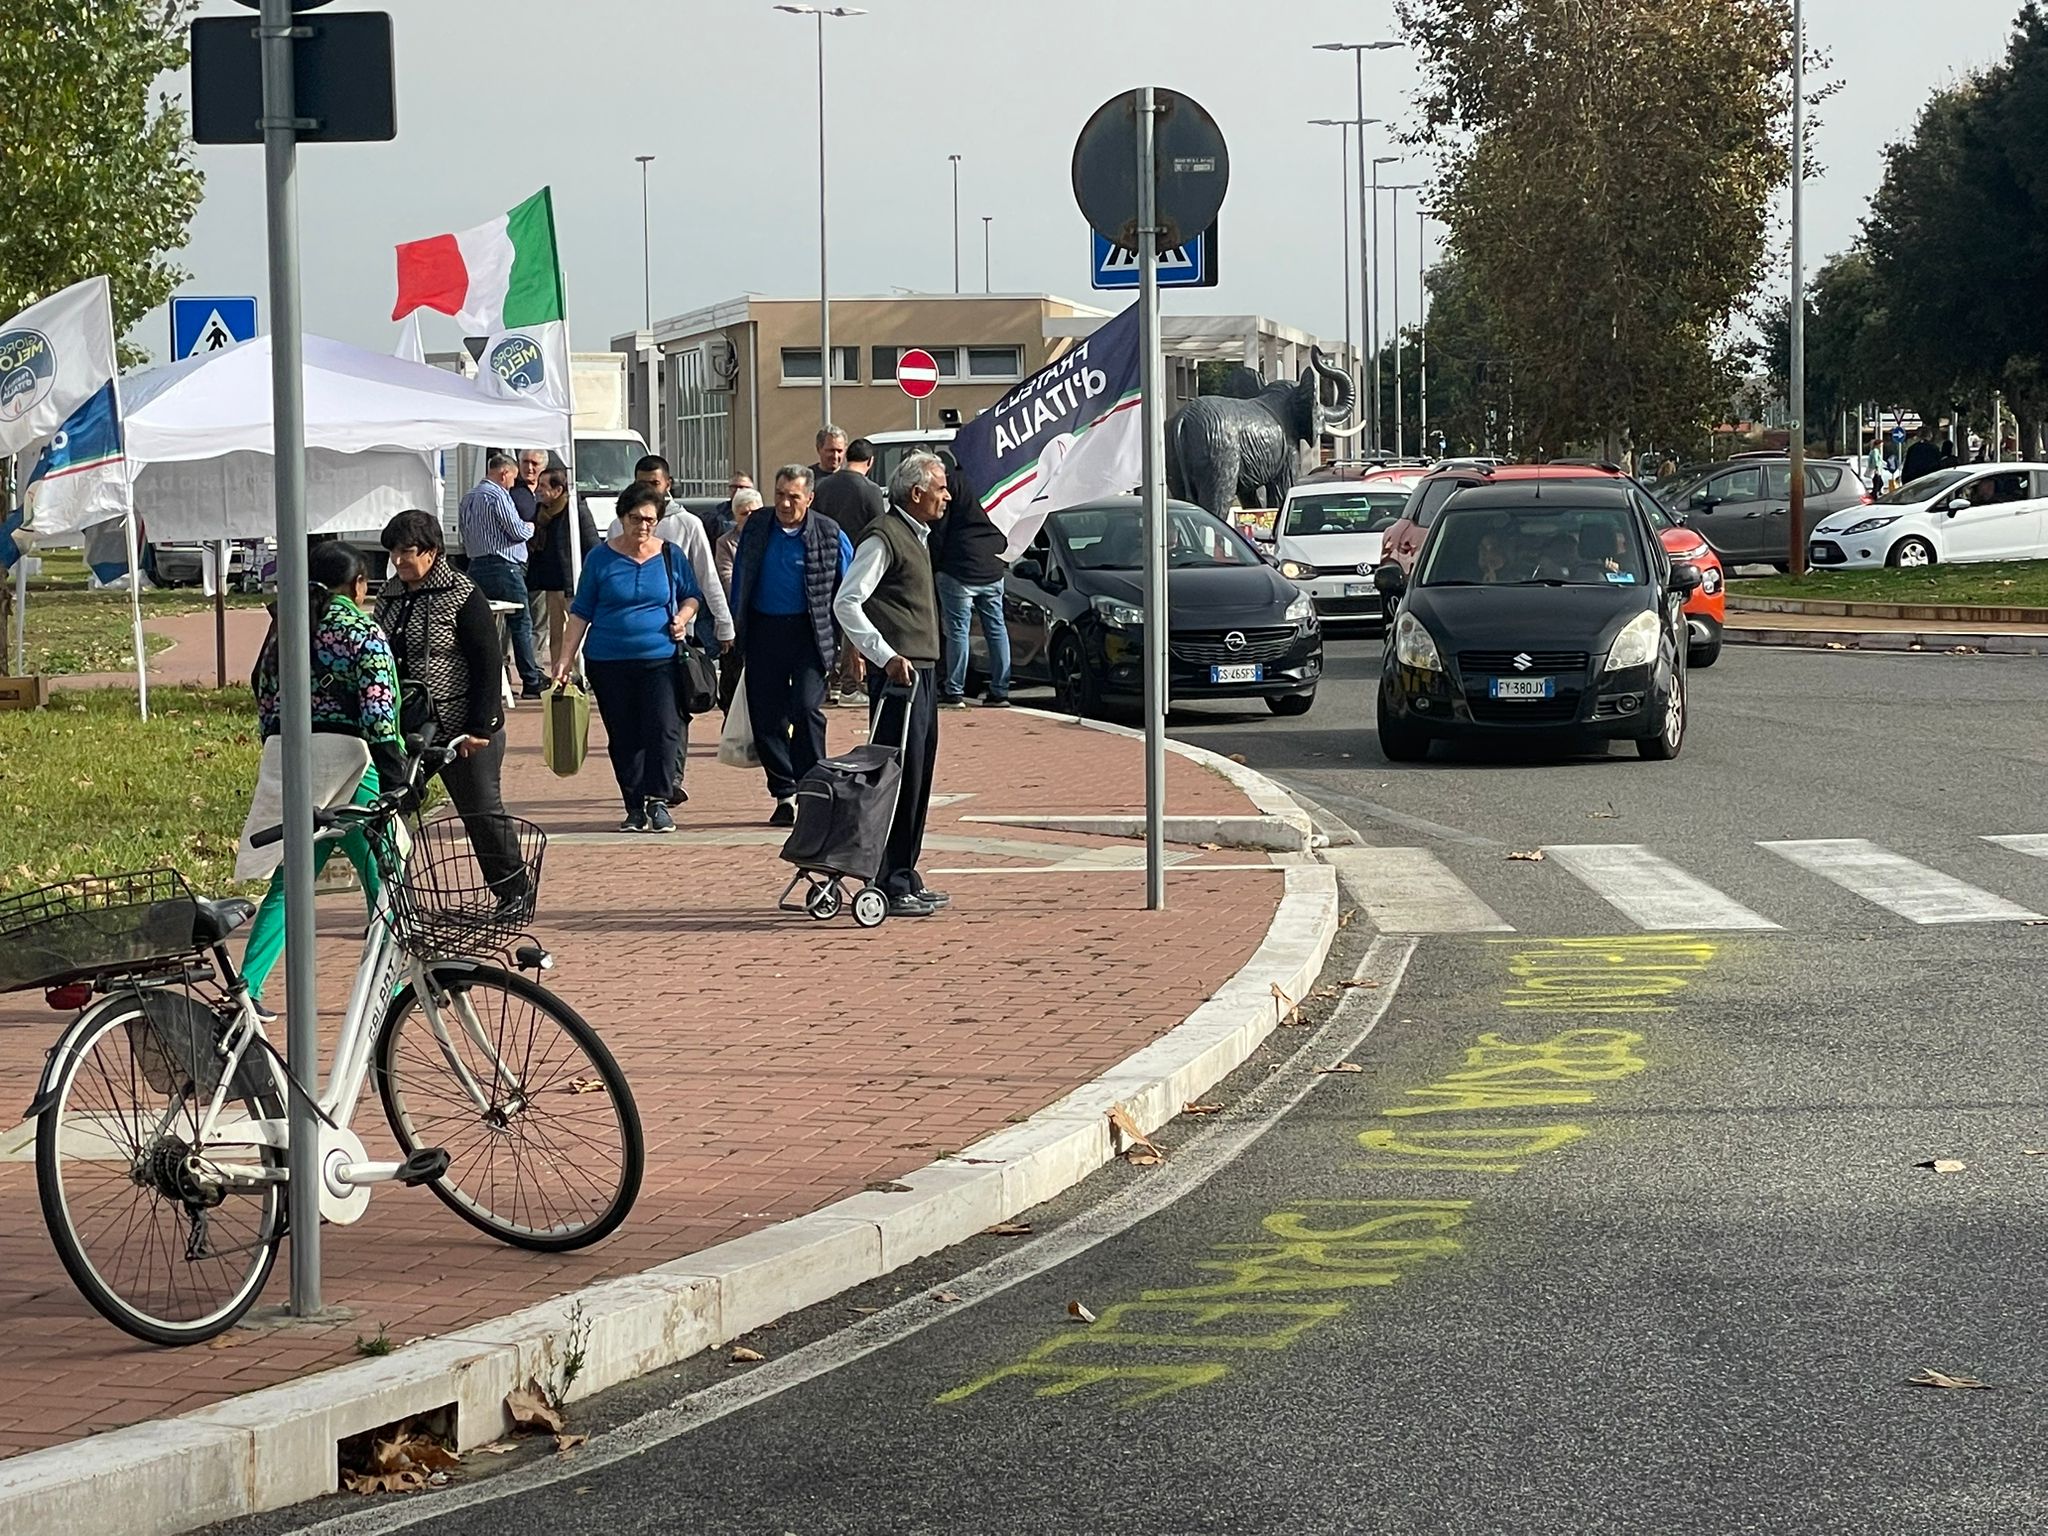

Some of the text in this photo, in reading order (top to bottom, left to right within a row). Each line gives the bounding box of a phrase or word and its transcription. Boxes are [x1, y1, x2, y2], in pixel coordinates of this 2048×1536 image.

[1499, 682, 1545, 694] FY 380JX
[1347, 1121, 1589, 1174] DI
[934, 1199, 1475, 1409] ISRAELE
